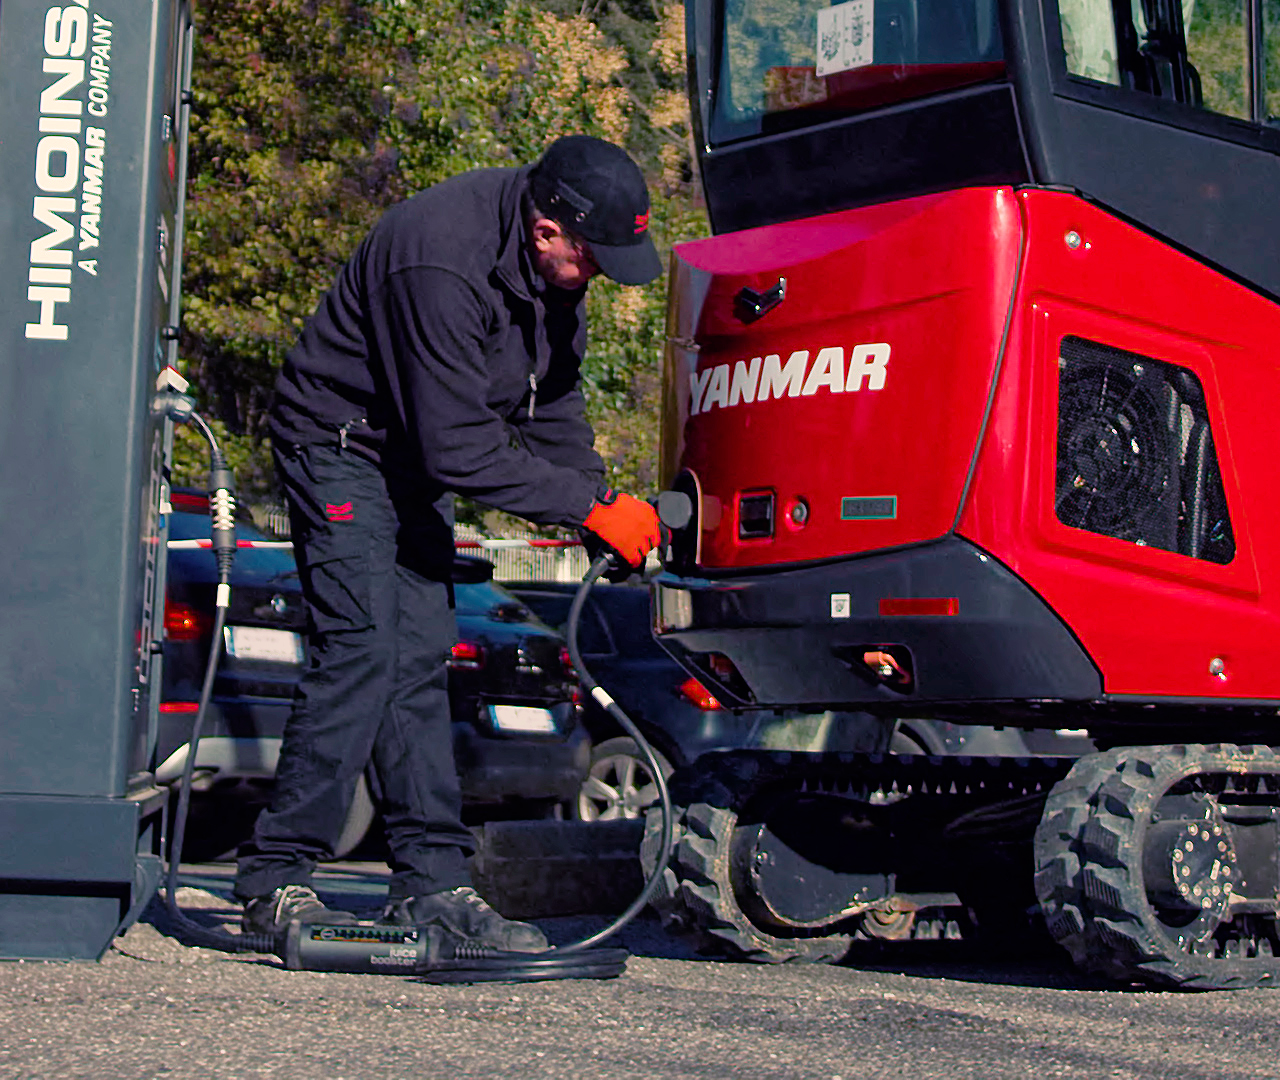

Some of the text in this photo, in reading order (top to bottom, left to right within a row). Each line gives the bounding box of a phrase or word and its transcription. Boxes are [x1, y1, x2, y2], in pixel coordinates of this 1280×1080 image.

[77, 13, 115, 277] A YANMAR COMPANY
[690, 342, 892, 416] YANMAR
[389, 945, 417, 958] juice
